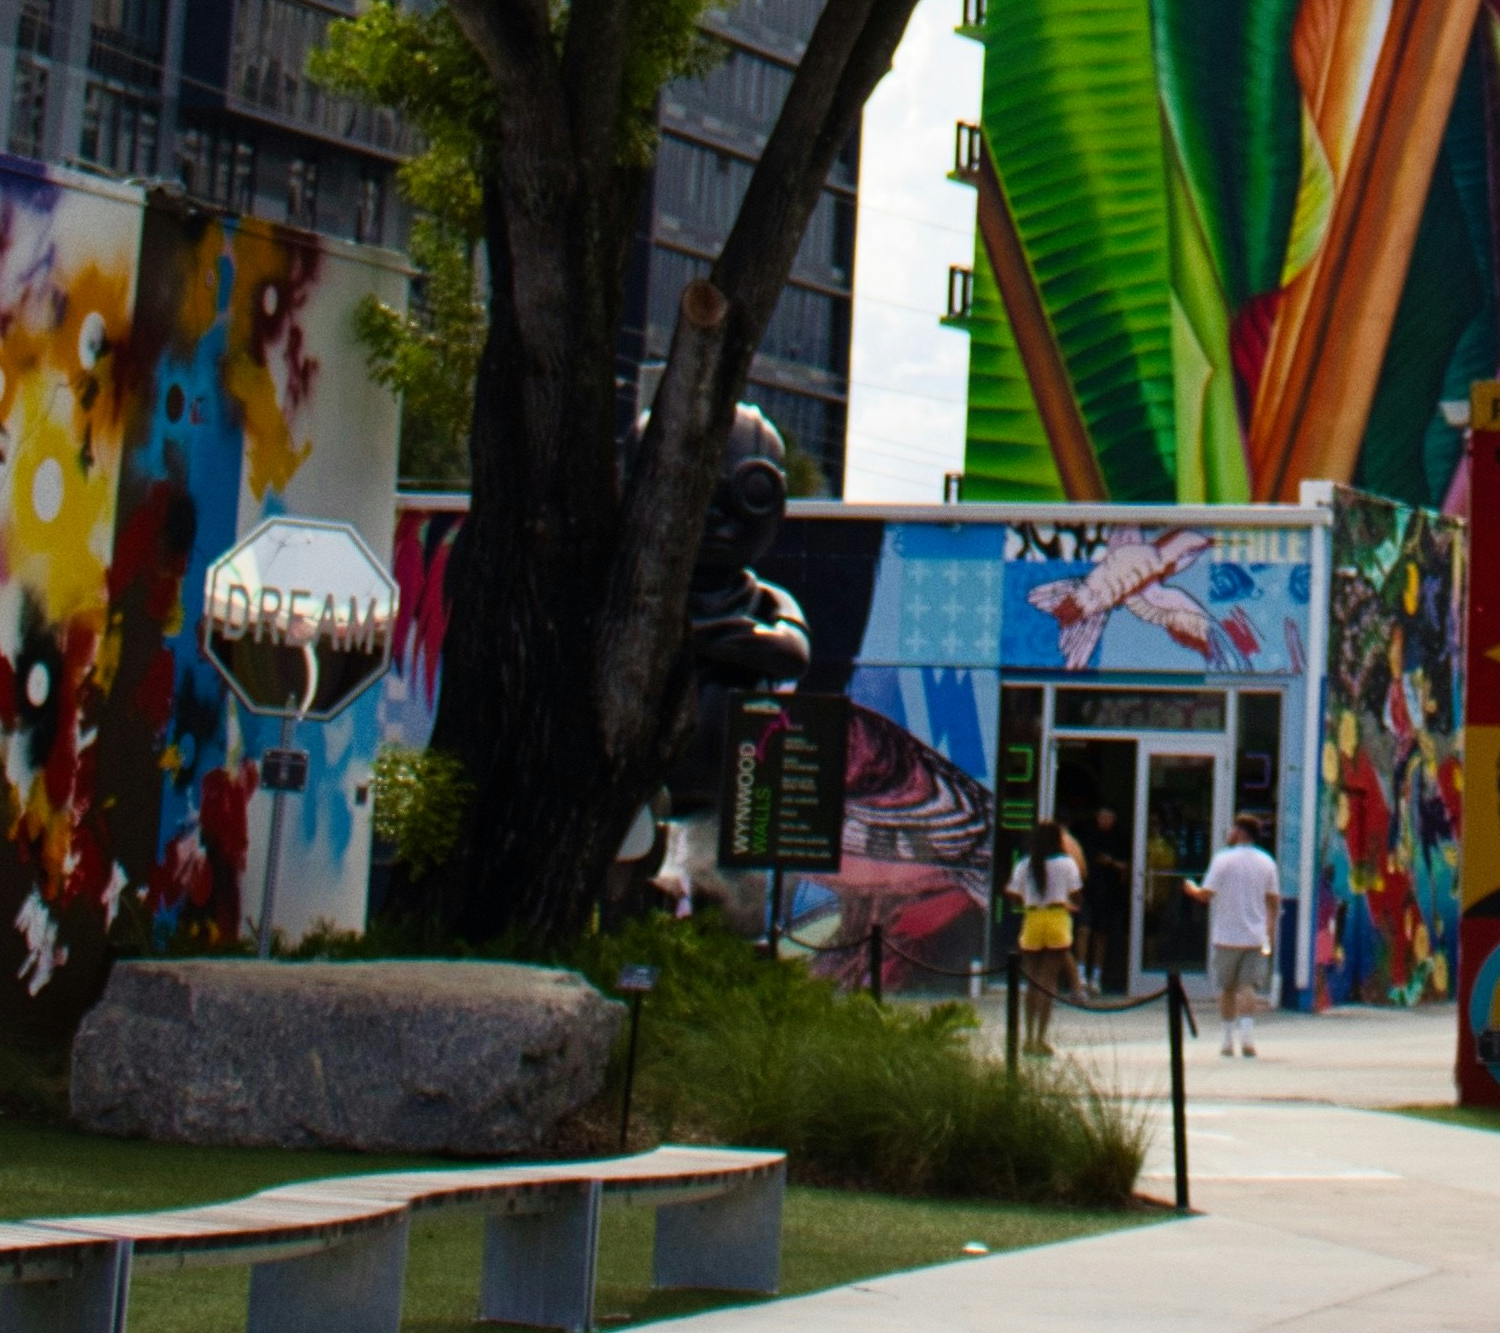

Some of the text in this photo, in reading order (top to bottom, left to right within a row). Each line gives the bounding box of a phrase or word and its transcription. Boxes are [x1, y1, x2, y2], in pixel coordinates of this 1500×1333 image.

[222, 582, 378, 656] DREAM
[732, 741, 757, 856] WYNWOOD
[752, 785, 773, 856] WALLS
